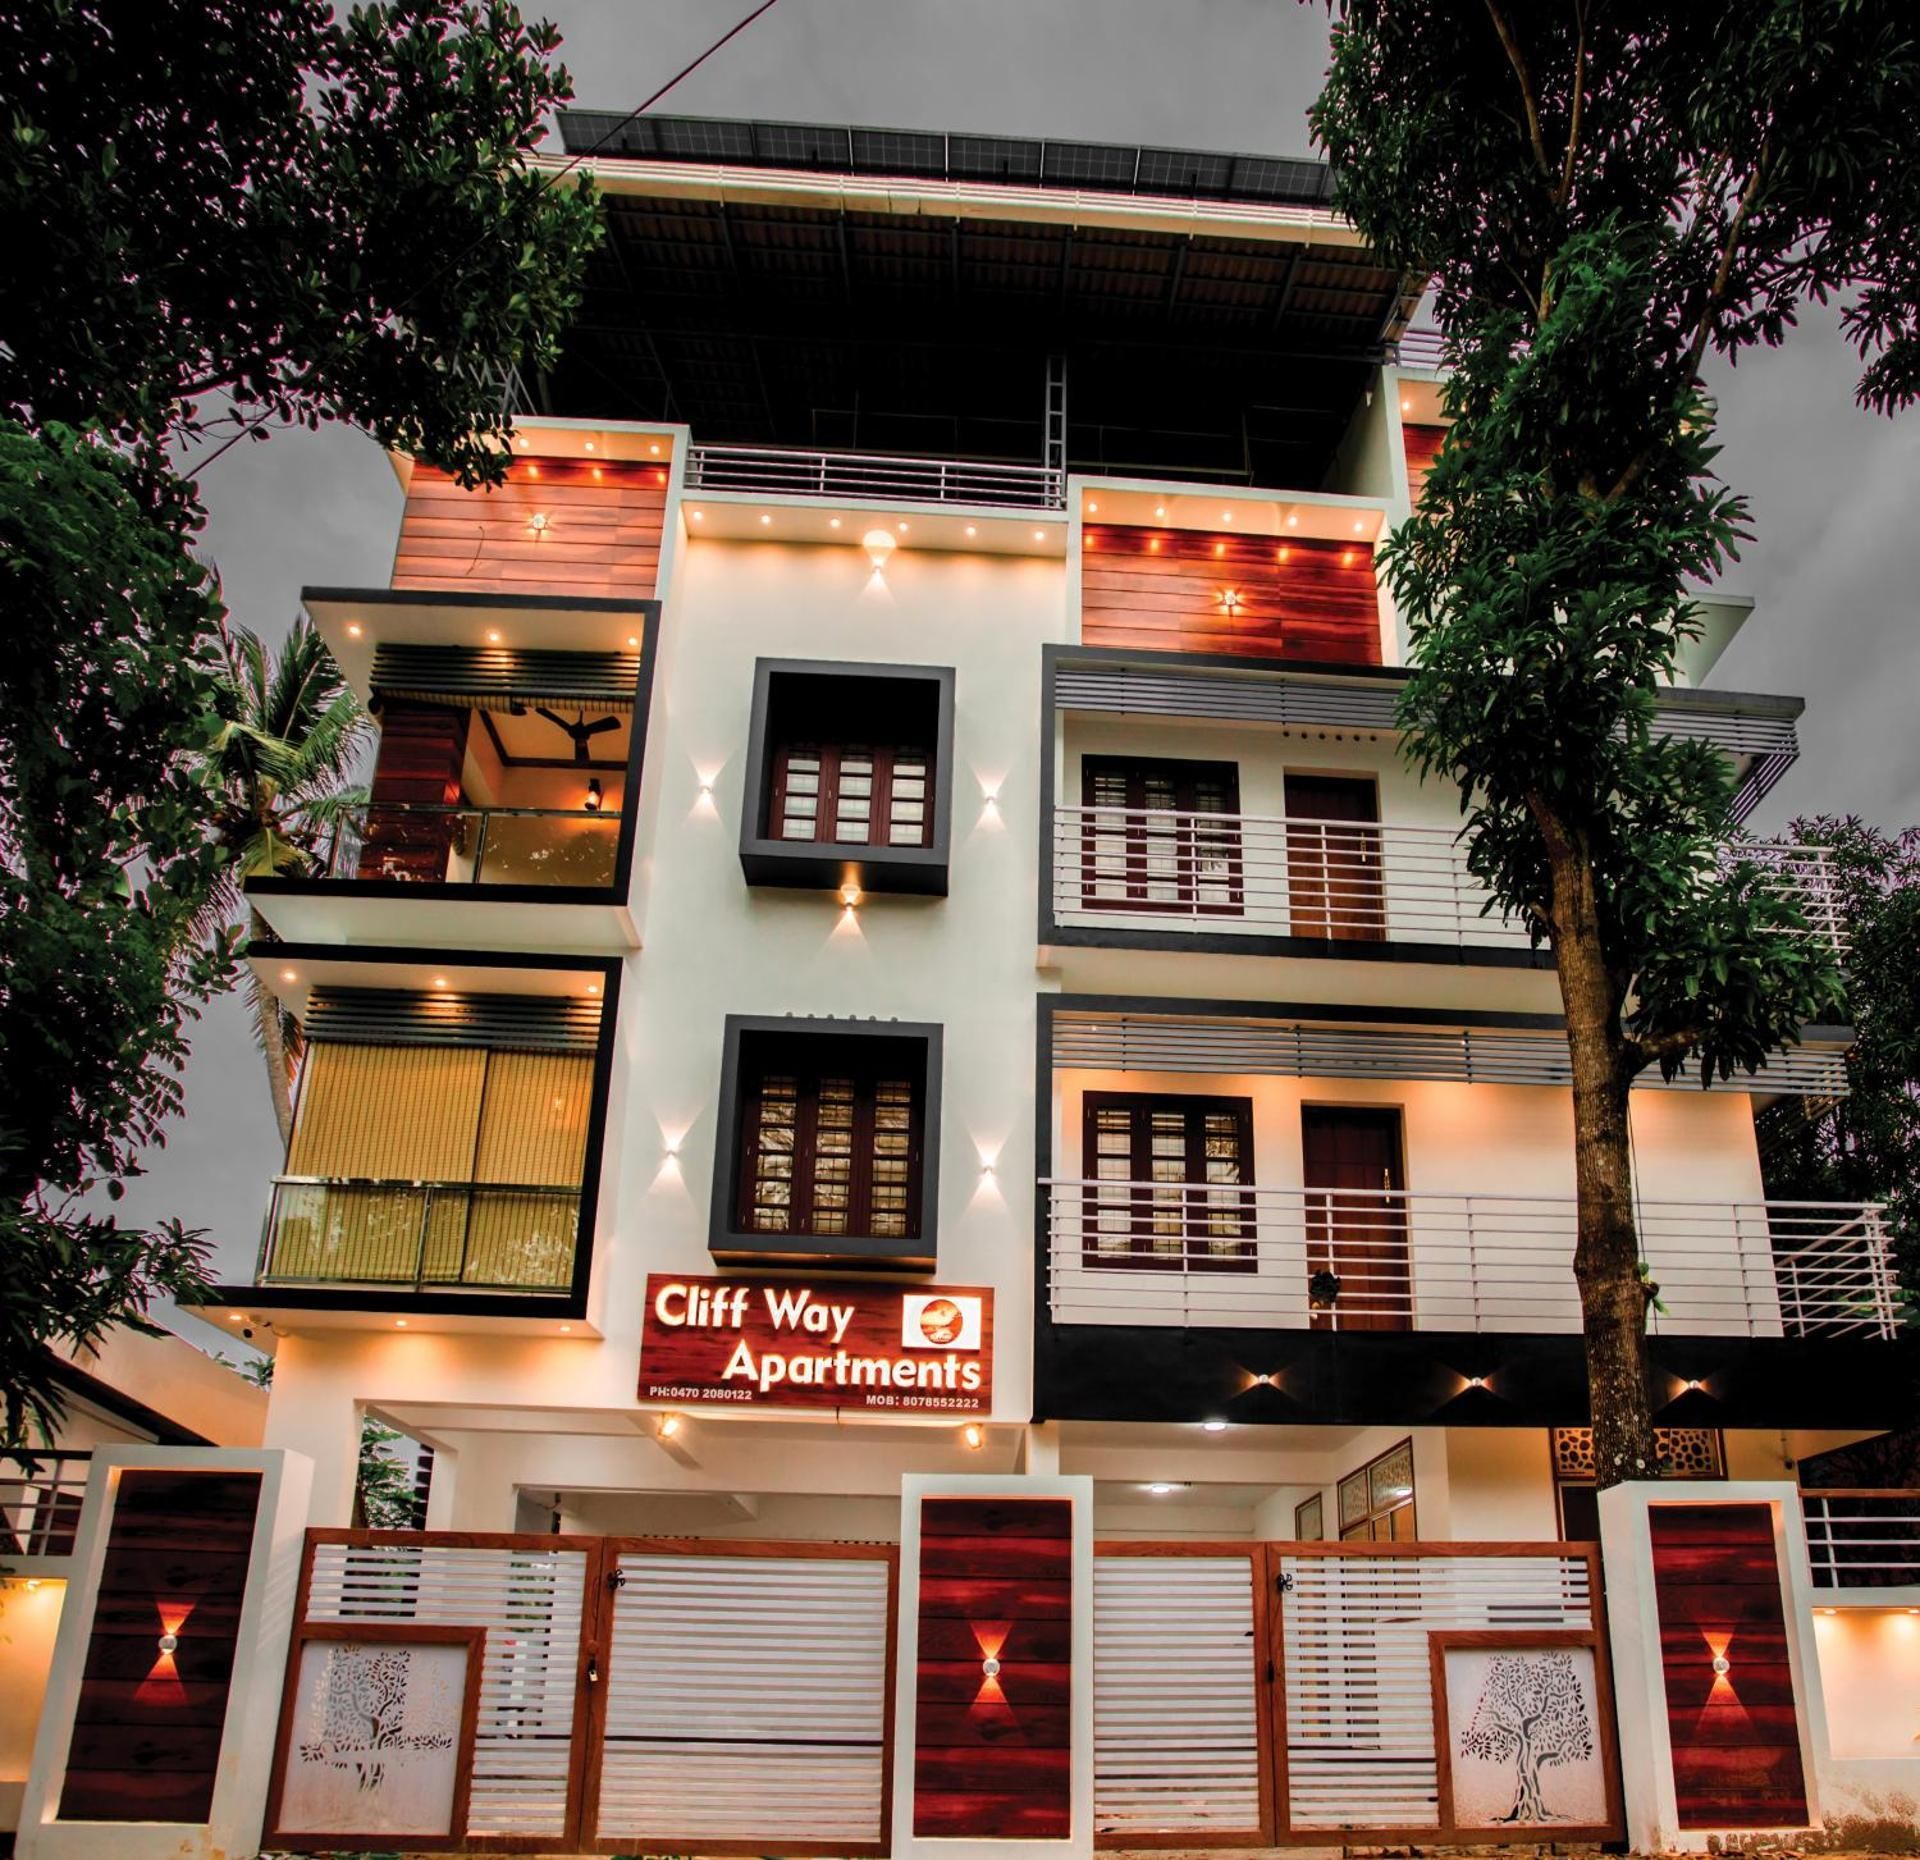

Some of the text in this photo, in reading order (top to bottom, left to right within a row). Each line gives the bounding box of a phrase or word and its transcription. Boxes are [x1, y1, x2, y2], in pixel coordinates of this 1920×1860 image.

[655, 1284, 854, 1344] Cliff Way
[721, 1339, 982, 1392] Apartments
[649, 1386, 752, 1400] PH:0470 2080122
[866, 1395, 979, 1408] MOB: 8078552222
